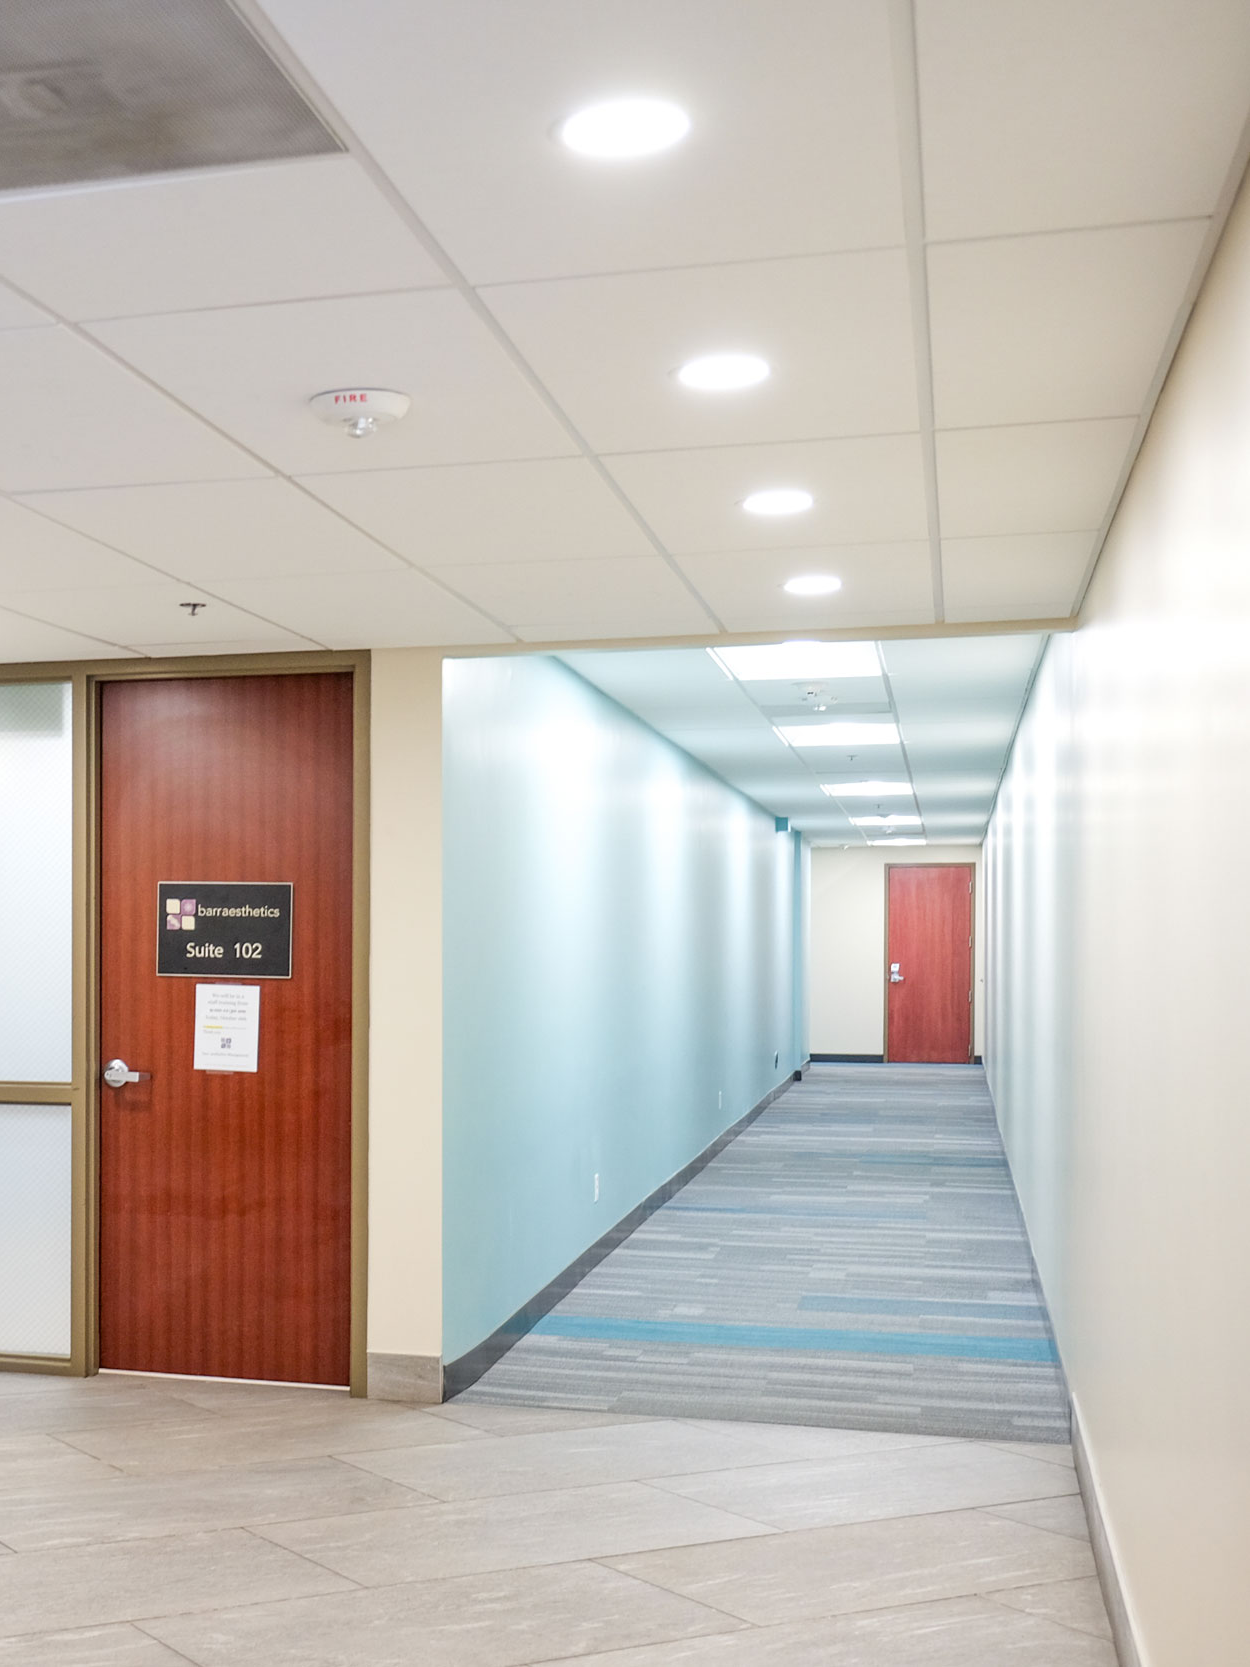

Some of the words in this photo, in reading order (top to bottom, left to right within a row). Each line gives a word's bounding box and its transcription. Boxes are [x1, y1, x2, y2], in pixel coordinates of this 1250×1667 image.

[334, 393, 367, 405] FIRE
[197, 903, 280, 918] barraesthetics
[186, 942, 224, 958] Suite
[234, 942, 262, 958] 102
